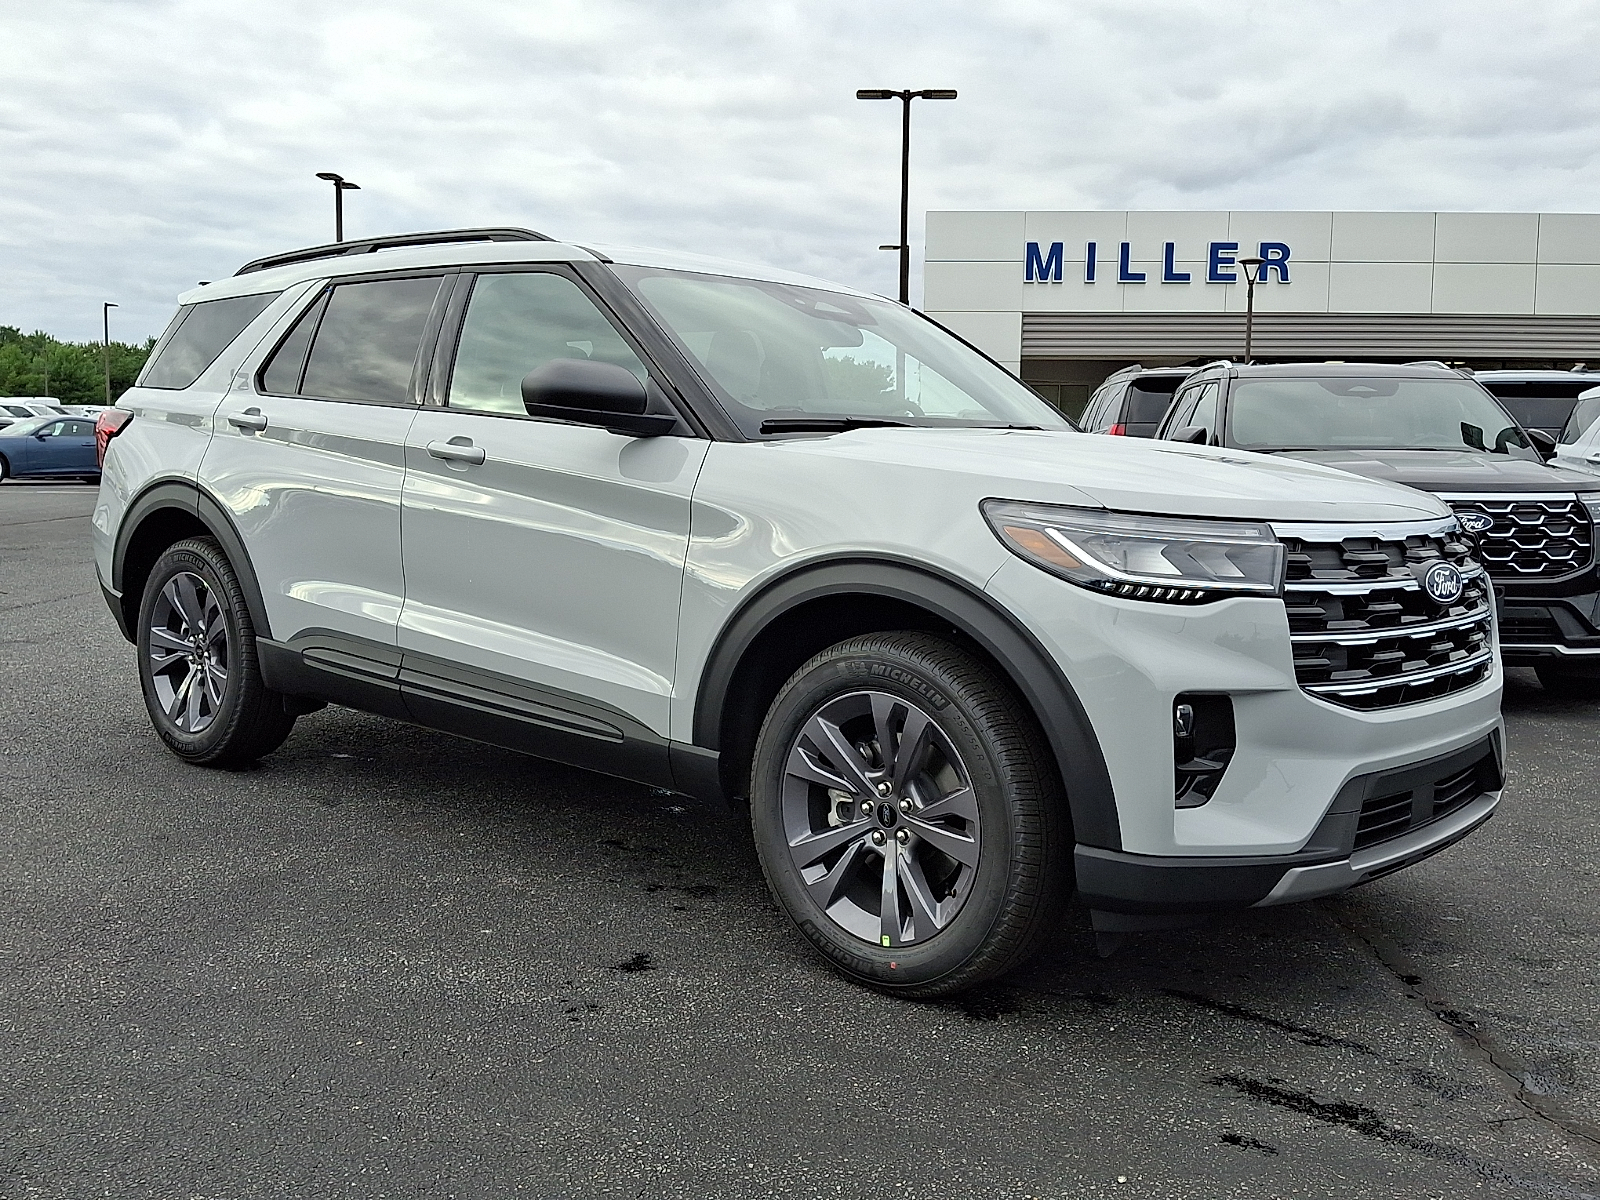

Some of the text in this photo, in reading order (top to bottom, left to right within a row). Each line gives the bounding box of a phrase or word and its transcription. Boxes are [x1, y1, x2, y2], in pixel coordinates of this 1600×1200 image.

[1024, 241, 1291, 283] MILLER
[172, 553, 205, 569] MICHELIN
[1433, 570, 1458, 595] Ford
[870, 664, 946, 708] MICHELIN
[803, 922, 873, 972] MICHELIN
